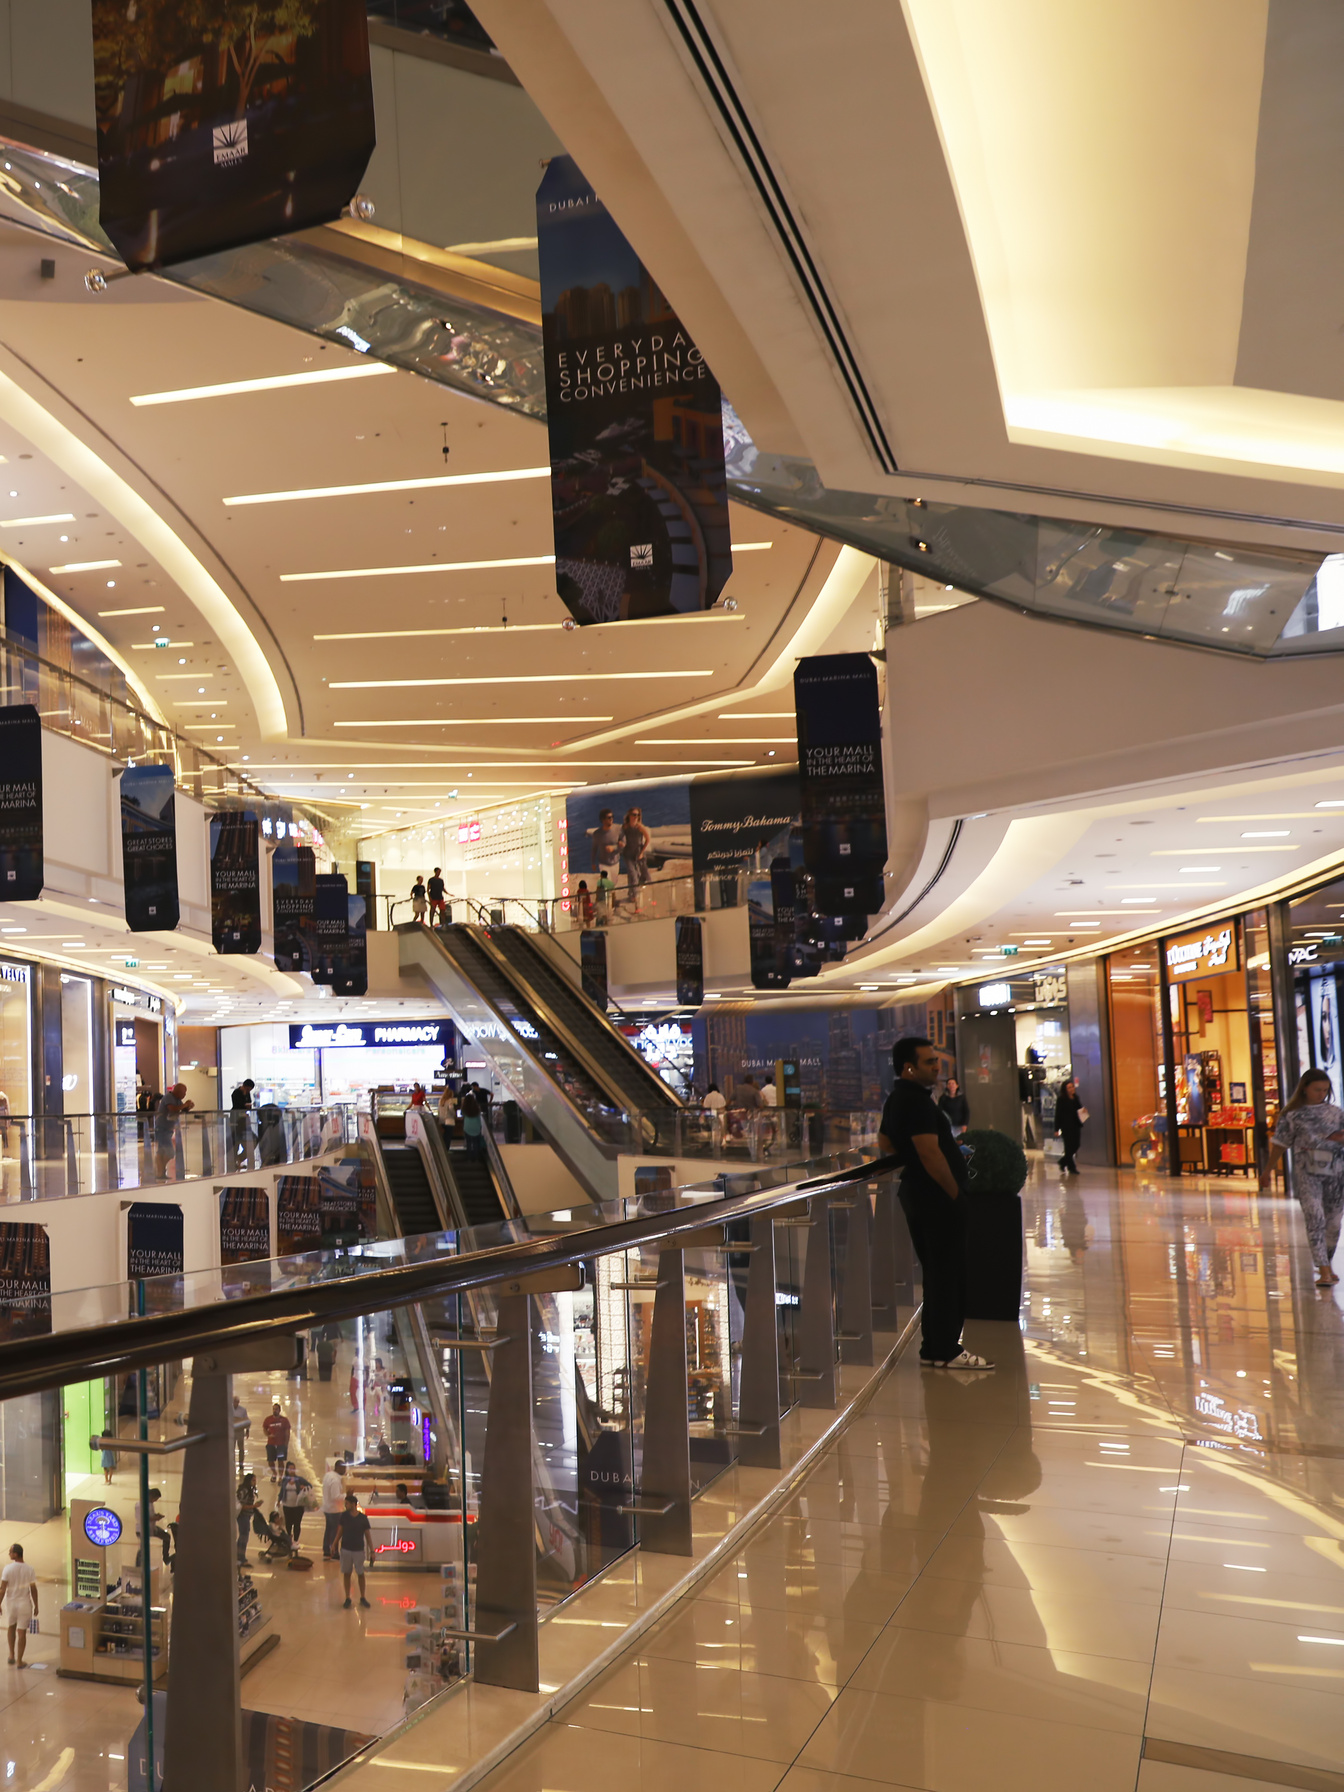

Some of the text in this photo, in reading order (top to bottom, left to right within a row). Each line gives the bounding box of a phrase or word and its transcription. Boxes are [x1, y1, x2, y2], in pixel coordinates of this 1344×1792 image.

[215, 147, 246, 162] EMAAR
[548, 194, 590, 213] DUBAI
[558, 333, 687, 369] EVERYDA
[560, 348, 704, 387] SHOPPING
[560, 364, 705, 402] CONVENIENCE
[806, 746, 874, 758] YOUR MALL
[817, 757, 833, 765] THE
[834, 755, 860, 764] HEART
[861, 754, 873, 762] OF
[807, 763, 874, 776] THE MARINA
[12, 783, 36, 792] MALL
[1, 800, 36, 809] MARINA
[700, 815, 791, 833] Tommy Bahama
[148, 837, 173, 845] STORES
[558, 819, 571, 897] MINISO
[375, 1026, 440, 1043] PHARMACY
[741, 1059, 765, 1067] DUBAI
[800, 1058, 821, 1066] MALL
[222, 1228, 246, 1236] YOUR
[236, 1242, 268, 1250] MARINA
[130, 1249, 182, 1260] YOUR MALL
[130, 1265, 182, 1274] THE MARINA
[21, 1280, 49, 1291] MALL
[9, 1298, 49, 1309] MARINA
[590, 1470, 640, 1485] DUBAI
